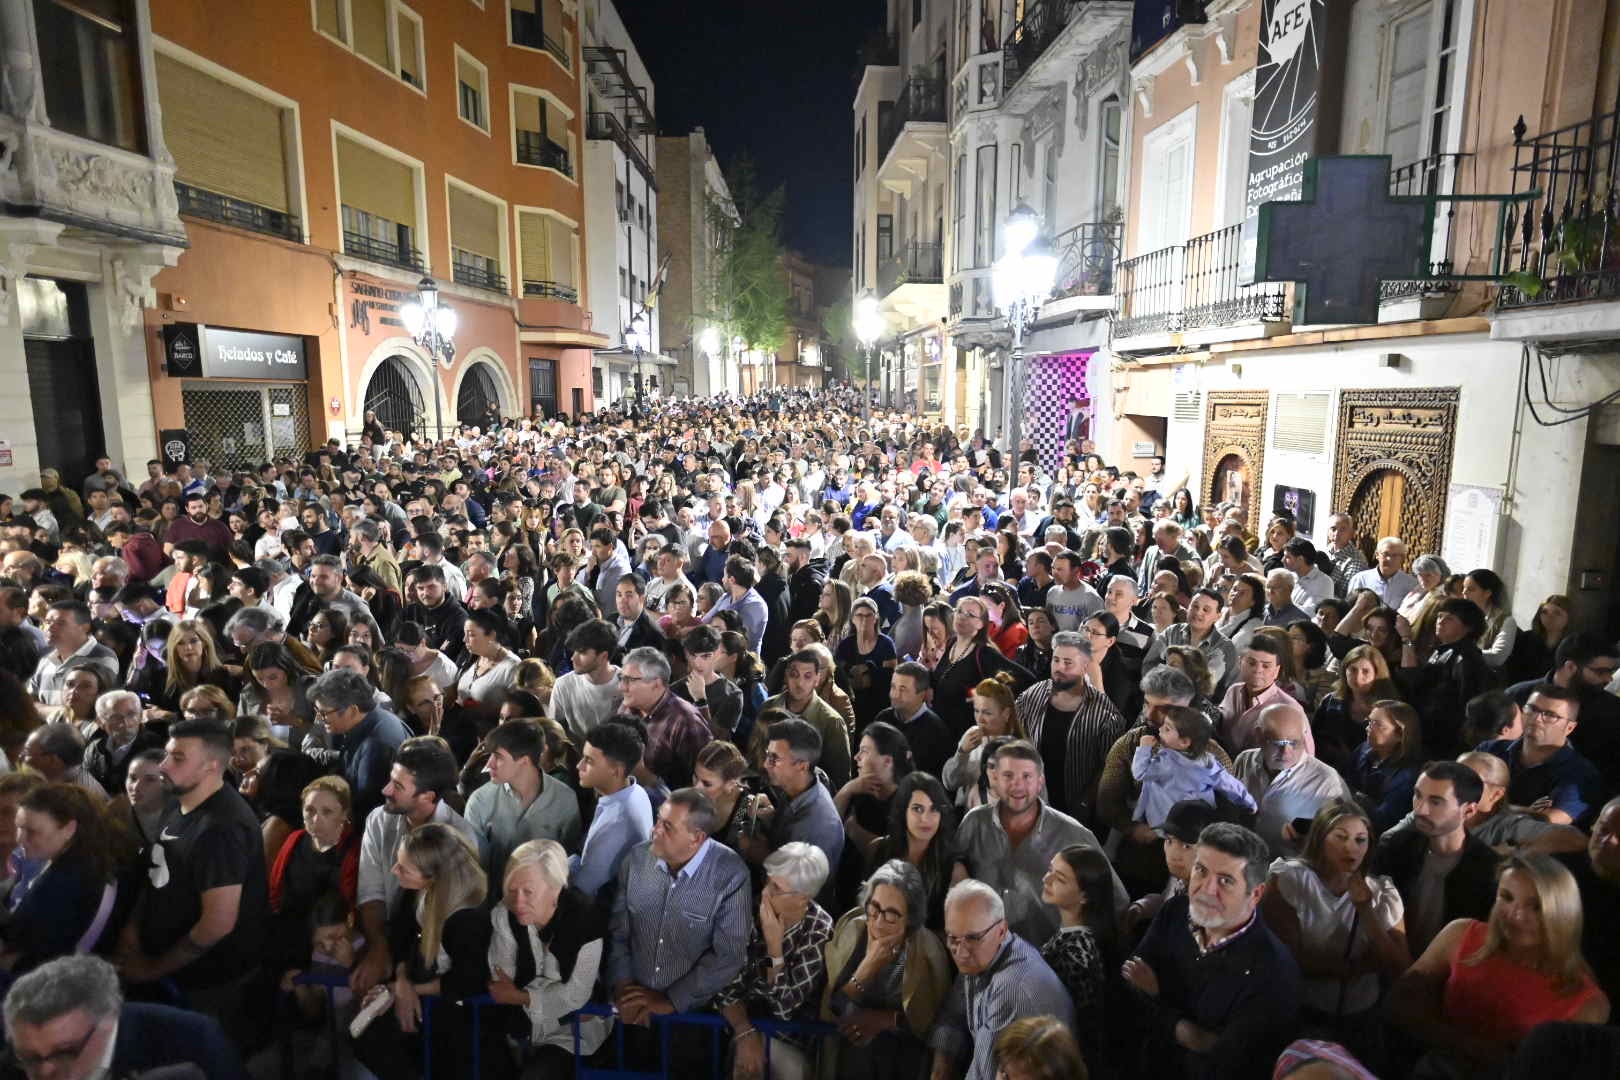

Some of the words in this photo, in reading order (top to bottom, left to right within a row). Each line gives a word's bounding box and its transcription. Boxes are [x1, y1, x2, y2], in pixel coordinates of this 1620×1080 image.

[1271, 2, 1305, 44] AFE
[1249, 151, 1308, 187] Agrupación
[218, 344, 264, 362] Helados
[266, 352, 273, 365] y
[274, 350, 298, 364] Café
